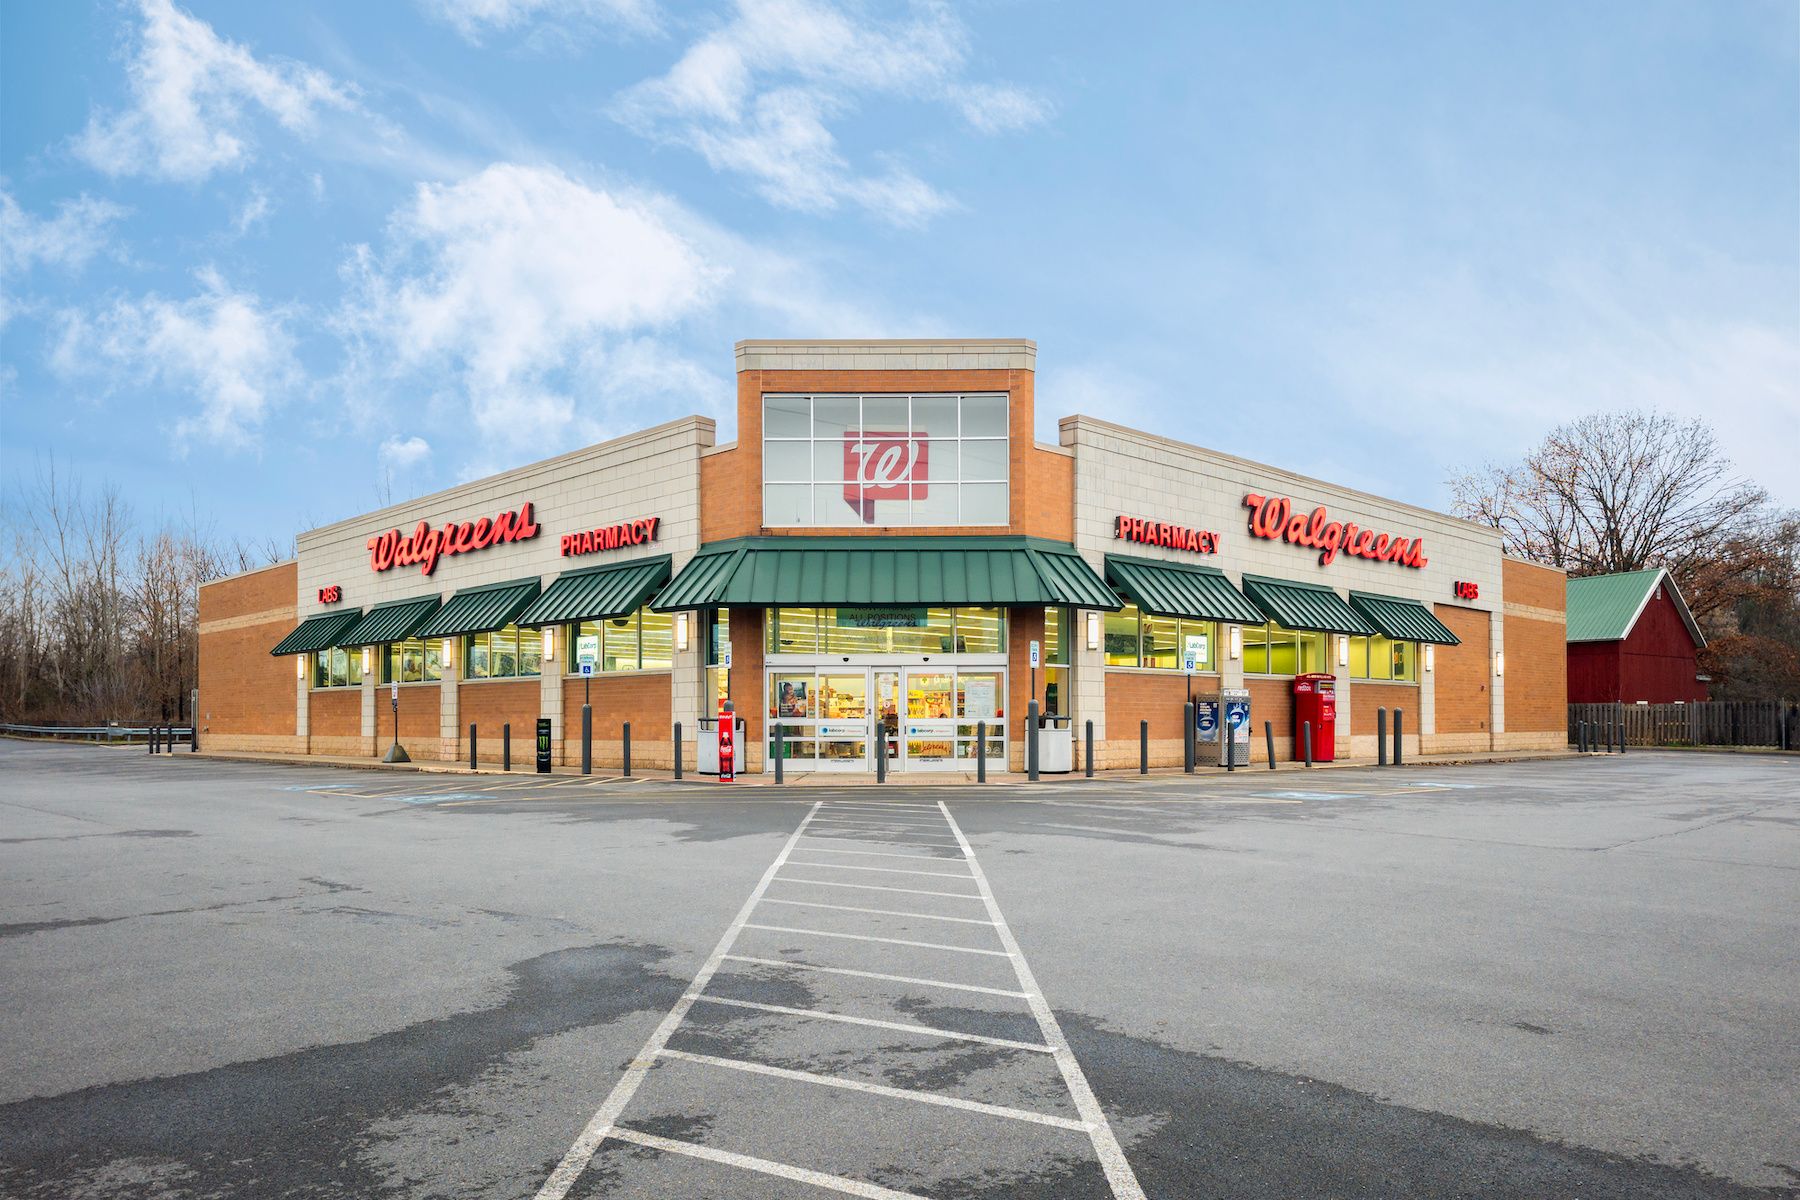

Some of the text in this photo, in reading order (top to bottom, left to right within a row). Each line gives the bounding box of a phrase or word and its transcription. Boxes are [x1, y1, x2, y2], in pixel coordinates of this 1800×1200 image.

[367, 501, 540, 576] Walgreens
[561, 517, 661, 557] PHARMACY
[1116, 515, 1221, 554] PHARMACY
[1244, 493, 1428, 567] Walgreens
[318, 585, 341, 604] LABS
[1455, 580, 1479, 600] LABS
[849, 613, 916, 621] ALL POSITIONS
